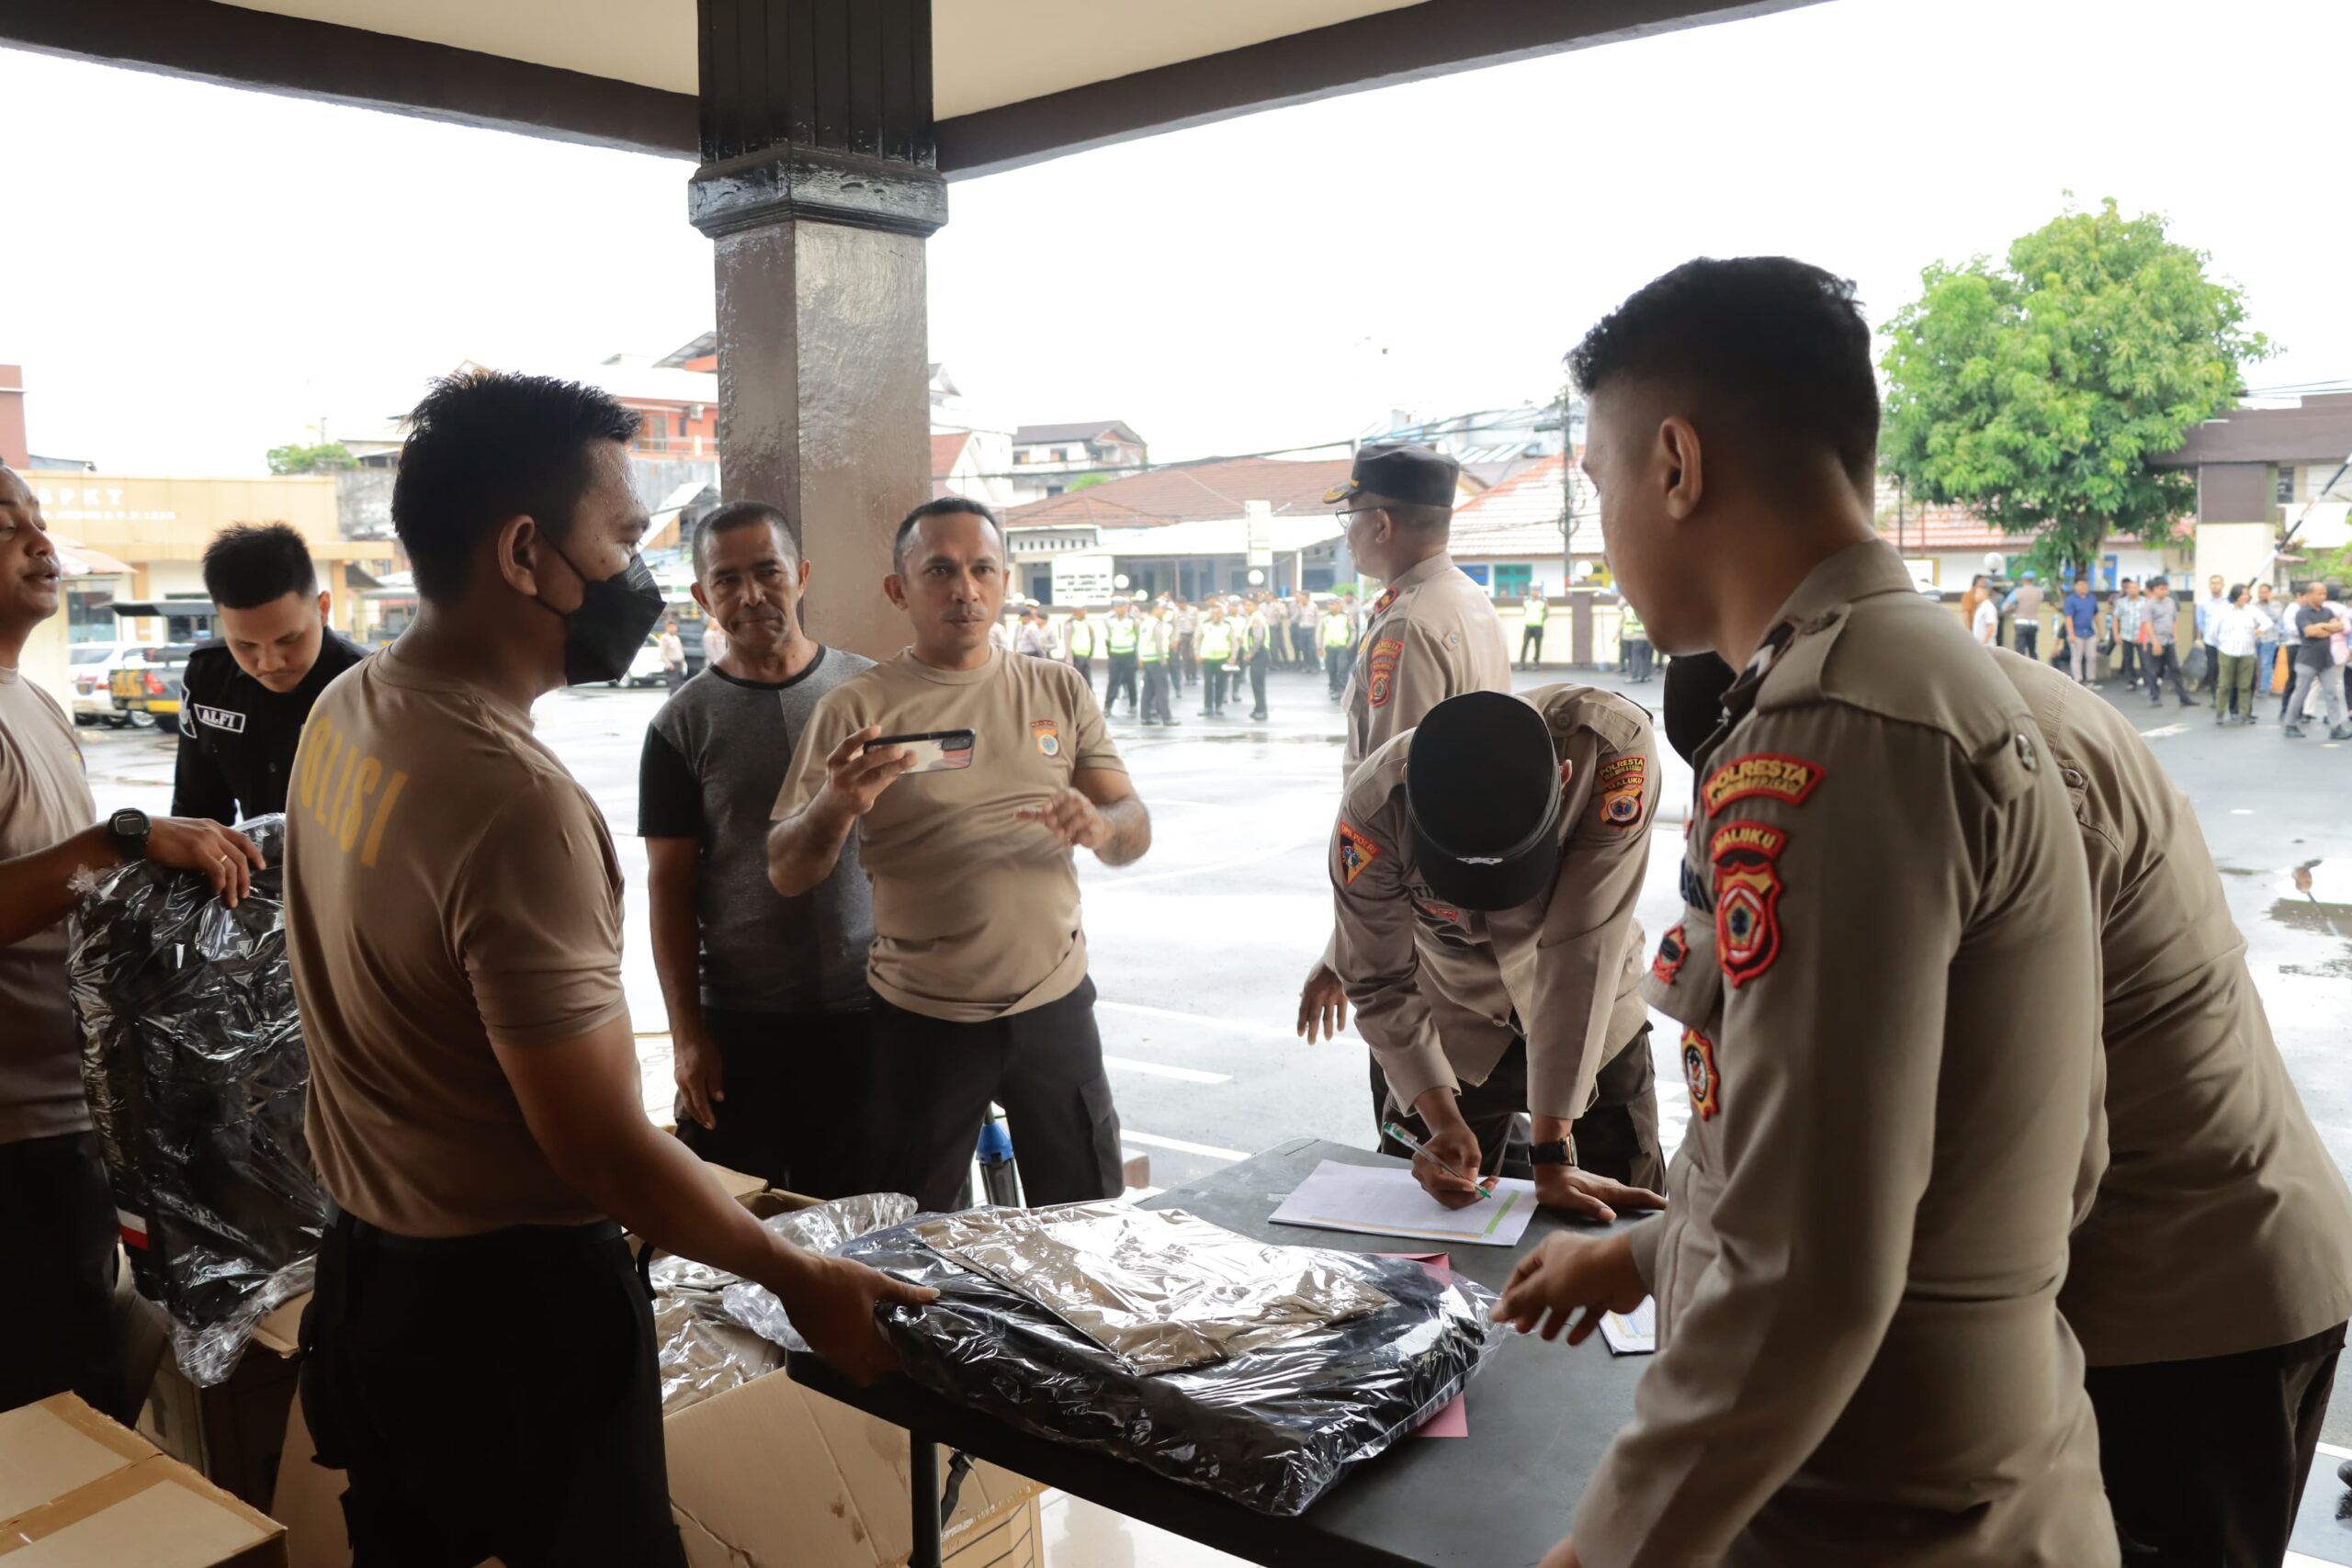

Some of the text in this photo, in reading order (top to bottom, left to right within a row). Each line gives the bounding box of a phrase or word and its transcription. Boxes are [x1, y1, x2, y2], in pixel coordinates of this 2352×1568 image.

[36, 488, 124, 505] SPKT
[201, 709, 236, 728] ALFI
[1600, 758, 1644, 778] POLRESTA
[300, 715, 410, 868] OLISI
[1707, 759, 1808, 802] POLRESTA
[1714, 827, 1777, 853] MALUKU
